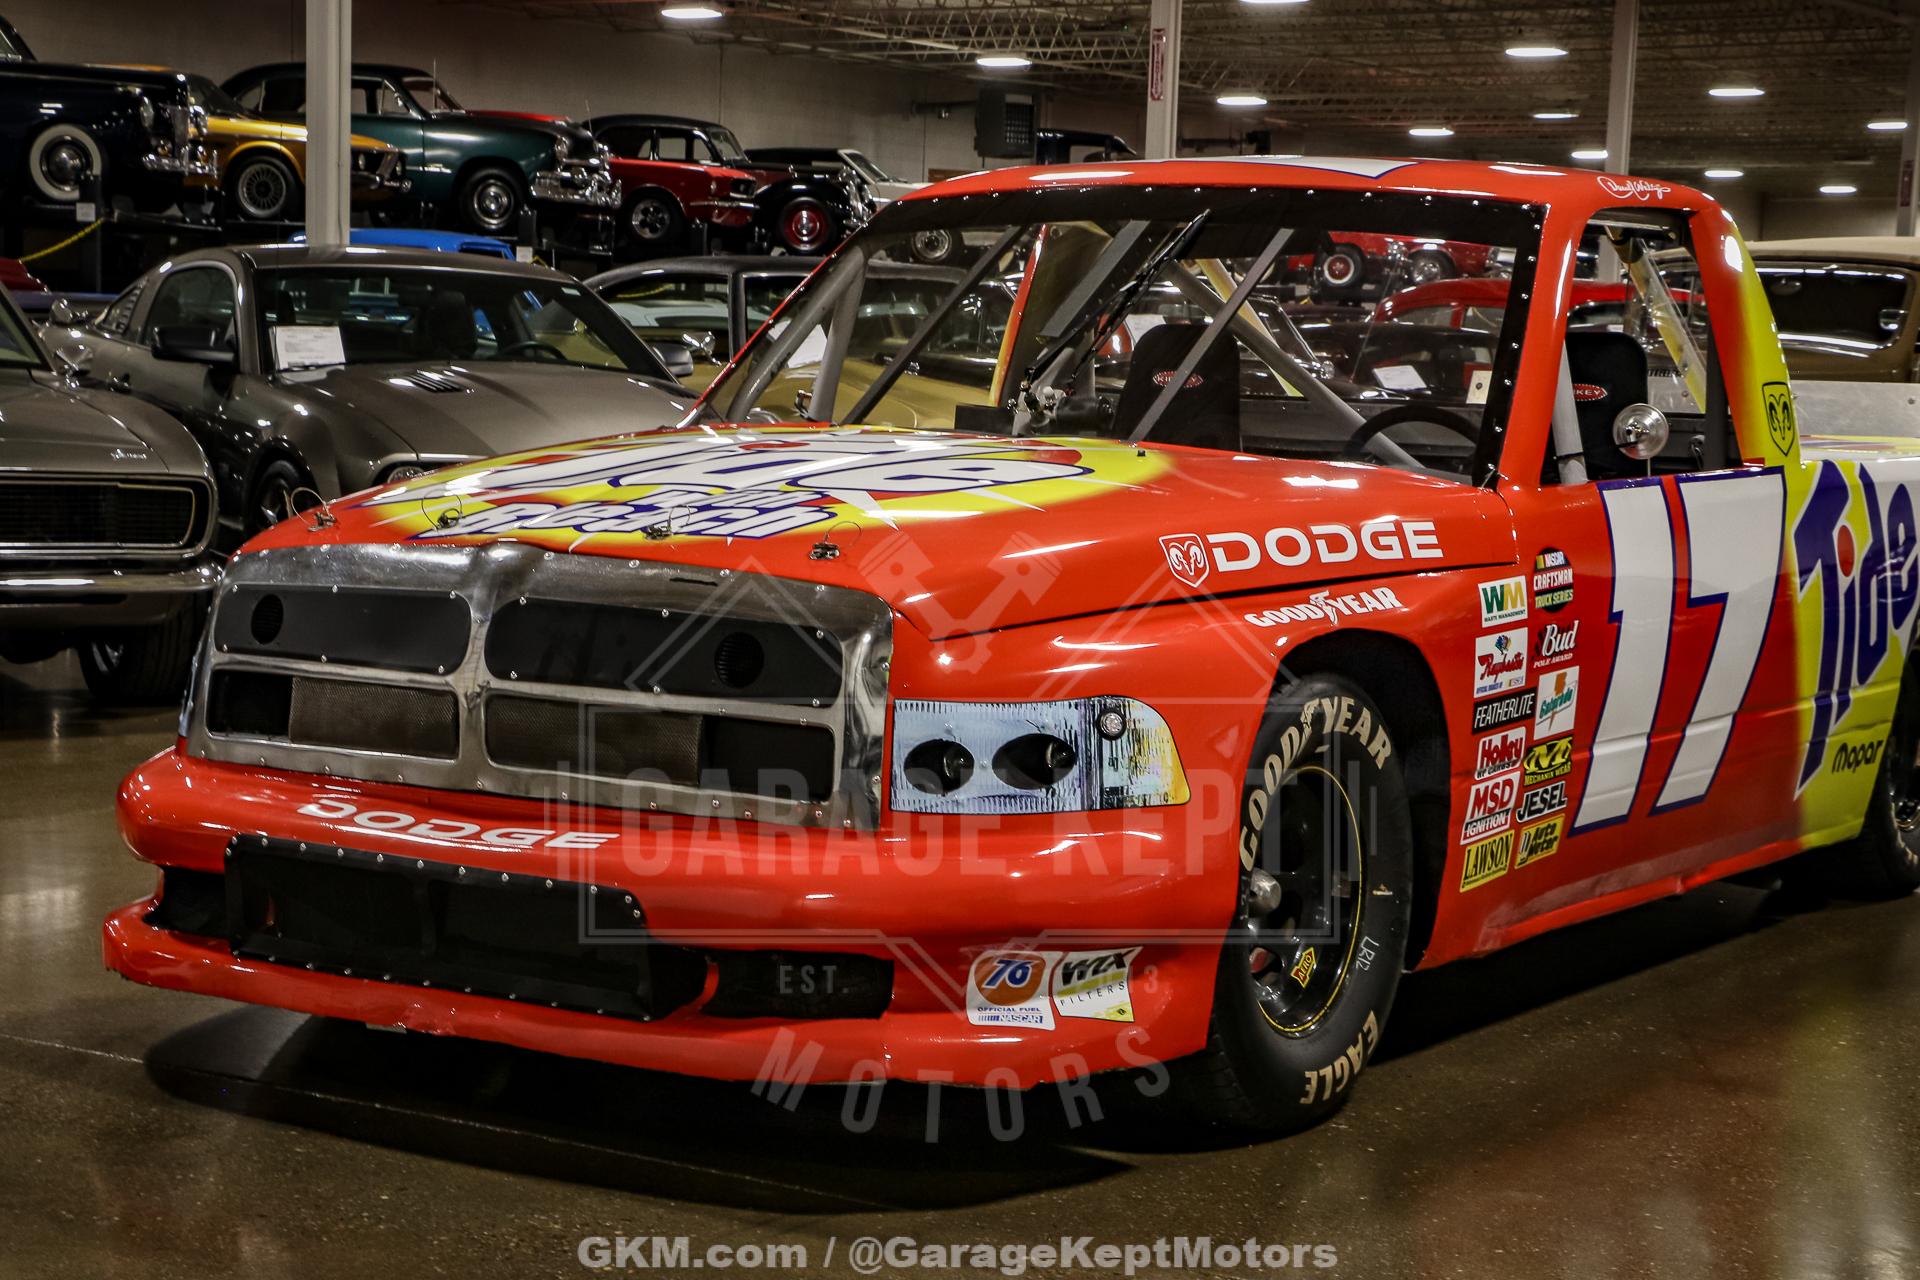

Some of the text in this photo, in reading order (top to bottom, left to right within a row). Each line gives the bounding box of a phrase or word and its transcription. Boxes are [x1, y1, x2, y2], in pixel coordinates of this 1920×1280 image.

[345, 432, 1095, 510] Tide
[409, 500, 838, 539] Bleach
[1206, 521, 1444, 572] DODGE
[1482, 581, 1525, 615] WM
[1533, 568, 1574, 592] CRAFTSMAN
[1535, 589, 1574, 609] TRUCK SERIES
[1244, 586, 1403, 627] GOODYEAR
[1541, 620, 1579, 657] Bud
[1795, 460, 1919, 799] Tide
[1533, 653, 1573, 669] POLE AWARD
[1567, 466, 1787, 836] 17
[1474, 692, 1536, 729] FEATHERLITE
[1831, 740, 1884, 775] Mopar
[1239, 696, 1391, 872] GOODYEAR
[1470, 778, 1514, 819] MSD
[1517, 782, 1568, 821] JESEL
[296, 799, 621, 849] DODGE
[1466, 812, 1506, 838] IGNITION
[1464, 833, 1513, 880] LAWSON
[981, 957, 1040, 990] 76
[1061, 948, 1136, 987] WIX
[1060, 981, 1126, 1006] FILTERS
[1000, 1014, 1043, 1024] NASCAR
[1299, 1009, 1379, 1105] EAGLE
